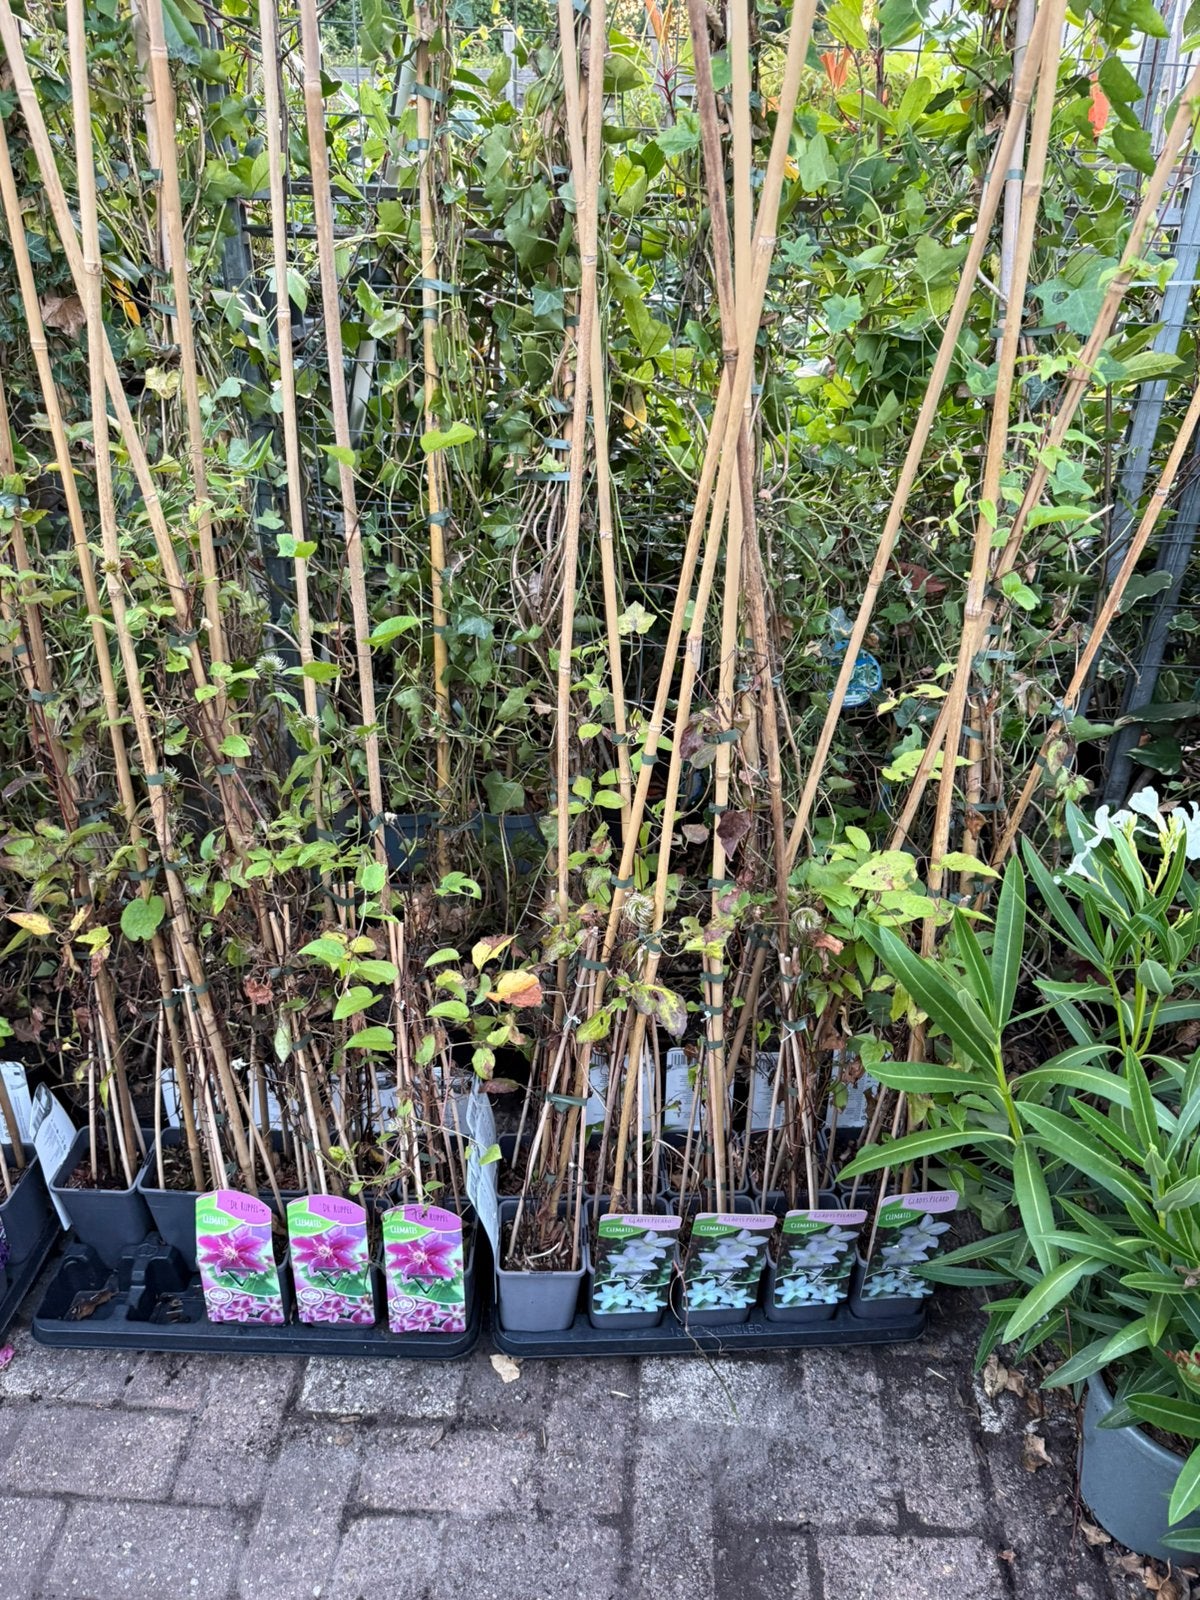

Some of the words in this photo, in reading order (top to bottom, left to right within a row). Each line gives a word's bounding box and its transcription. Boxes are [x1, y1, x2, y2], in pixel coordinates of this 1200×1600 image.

[202, 1214, 229, 1227] CLEMATIS
[885, 1211, 911, 1221] CLEMATIS
[295, 1217, 322, 1228] CLEMATIS
[390, 1225, 418, 1235] CLEMATIS
[700, 1224, 728, 1232] CLEMATIS
